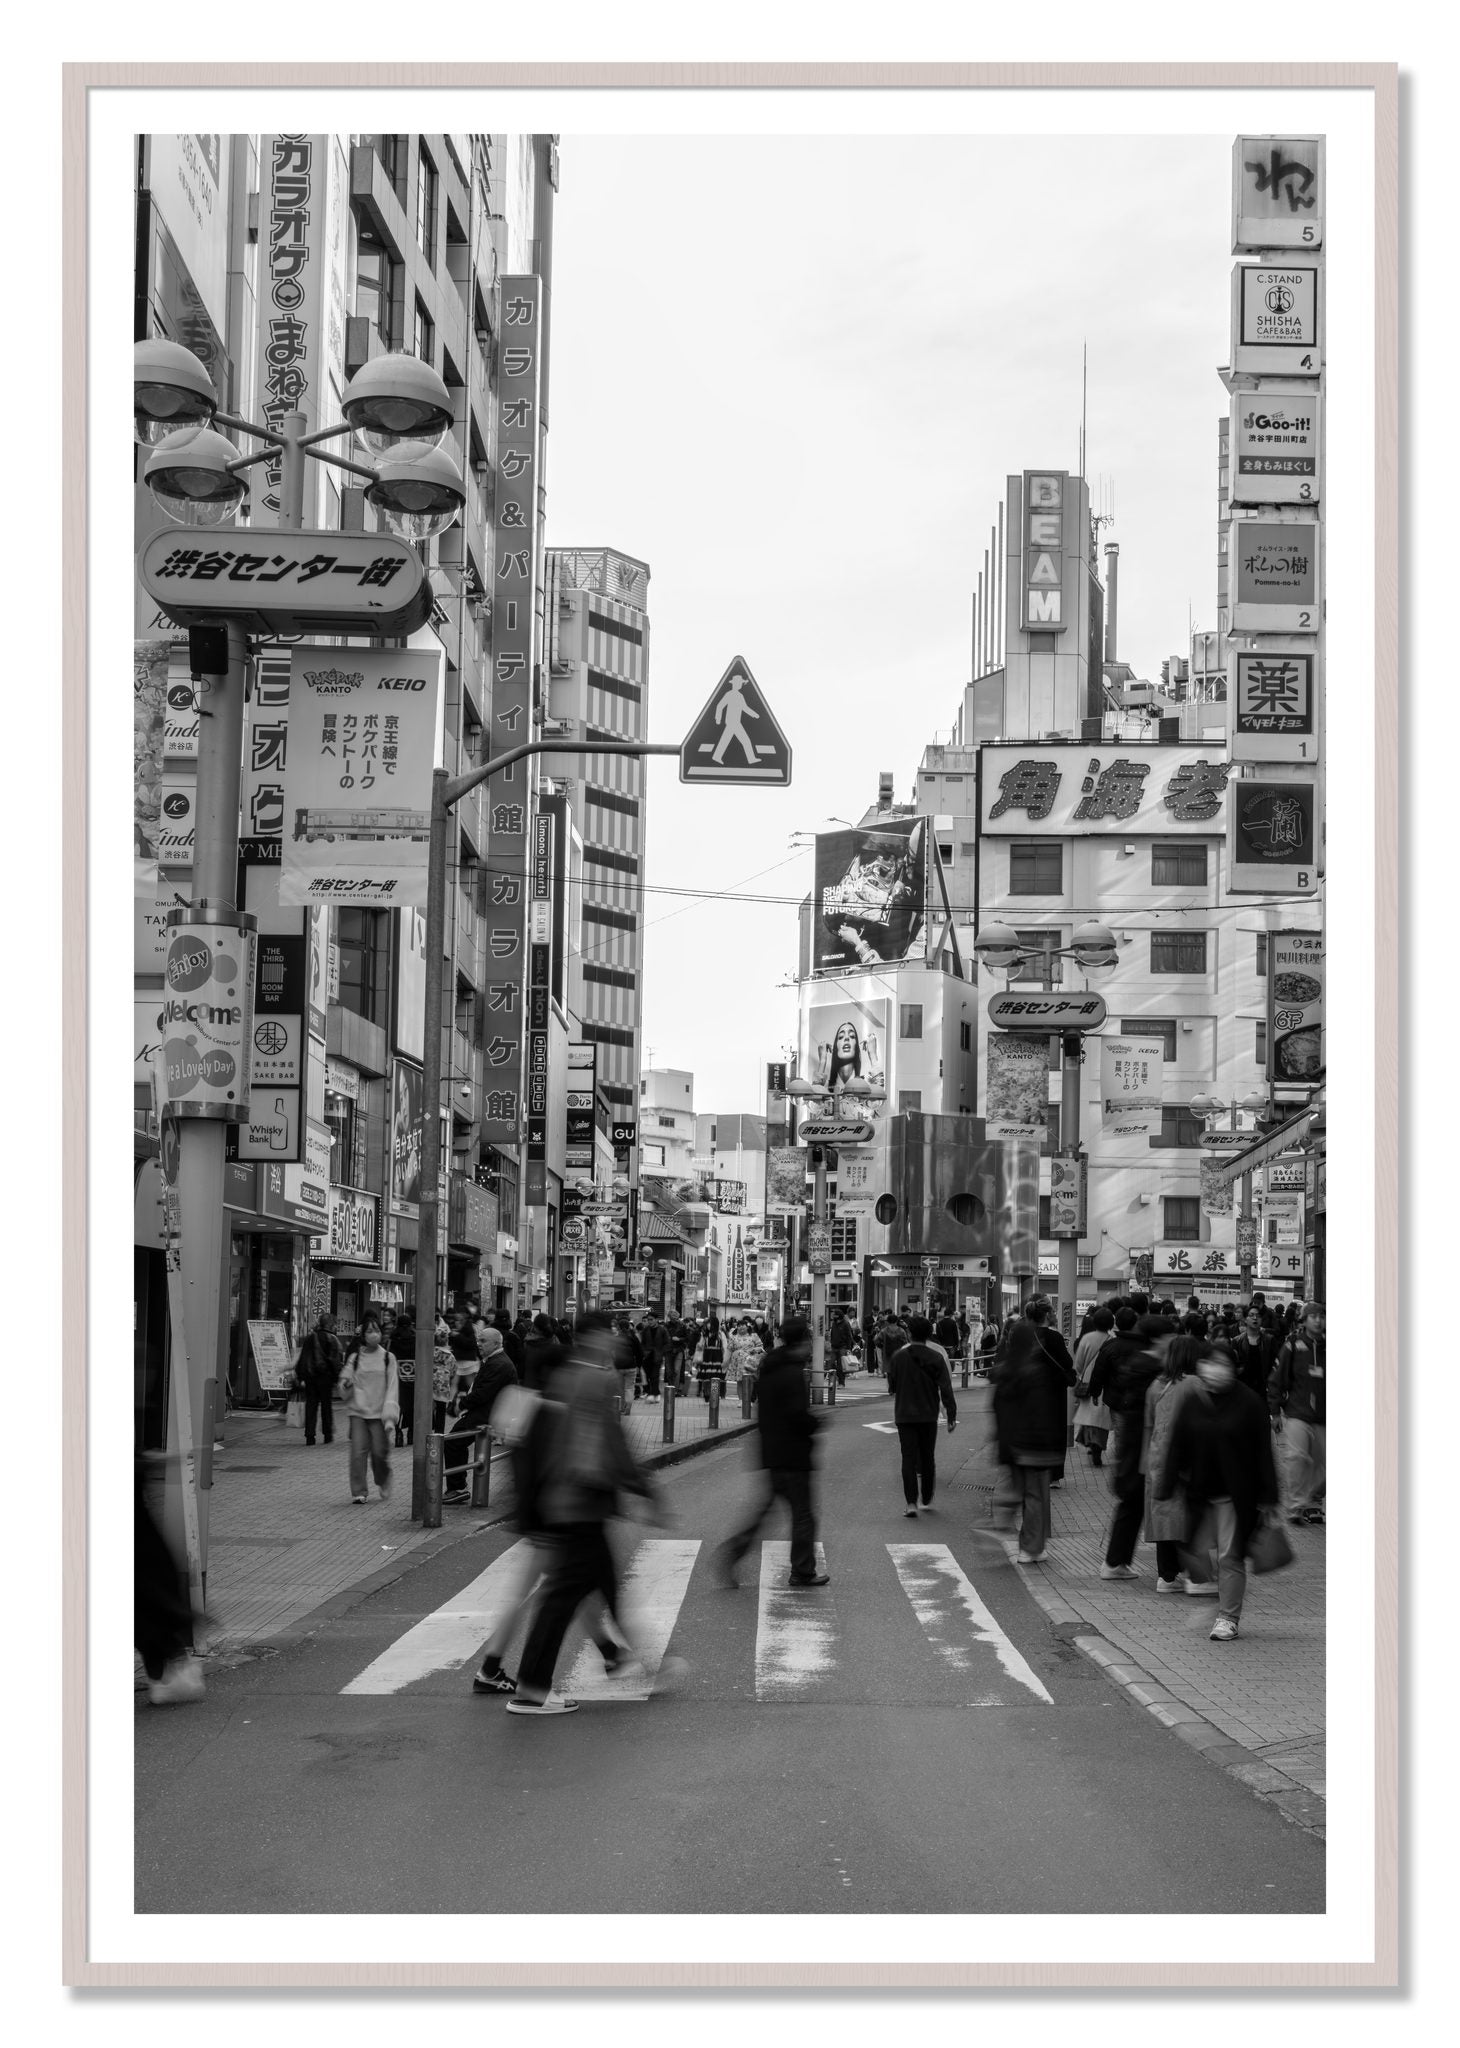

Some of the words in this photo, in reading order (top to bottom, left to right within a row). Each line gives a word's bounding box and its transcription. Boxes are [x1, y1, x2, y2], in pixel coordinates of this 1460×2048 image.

[1302, 226, 1315, 242] 5
[1257, 274, 1303, 284] C.STAND
[1257, 316, 1302, 326] SHISHA
[1257, 327, 1302, 335] CAFE&BAR
[1300, 354, 1313, 370] 4
[1255, 414, 1311, 431] Goo-it!
[1243, 460, 1312, 472] 全身もみほぐし
[1299, 483, 1311, 500] 3
[1029, 475, 1062, 623] BEAM
[154, 549, 408, 588] 渋谷センター街
[1298, 612, 1311, 628] 2
[316, 686, 351, 694] KANTO
[377, 677, 427, 691] KEIO
[1247, 661, 1299, 713] 薬
[320, 713, 337, 758] 冒険へ
[168, 742, 193, 751] 渋谷店
[339, 713, 357, 789] カントーの
[360, 713, 379, 790] ポケパーク
[382, 714, 400, 776] 京王線で
[1299, 742, 1307, 757] 1
[988, 759, 1233, 820] 角海老
[538, 819, 546, 855] kimono
[164, 850, 190, 859] 渋谷店
[308, 878, 398, 892] 渋谷センター街
[1297, 872, 1309, 888] B
[168, 949, 209, 985] Enjoy
[265, 994, 280, 1002] BAR
[164, 1000, 242, 1026] Welcome
[995, 1001, 1100, 1015] 渋谷センター街
[1274, 1011, 1304, 1030] 6F
[182, 1058, 212, 1078] Lovely
[214, 1059, 234, 1074] Day!
[250, 1125, 284, 1137] Whisky
[614, 1128, 635, 1139] GU
[802, 1125, 865, 1135] 渋谷センター街
[249, 1135, 270, 1143] Bank
[734, 1248, 743, 1290] BEER
[732, 1292, 747, 1300] HALL
